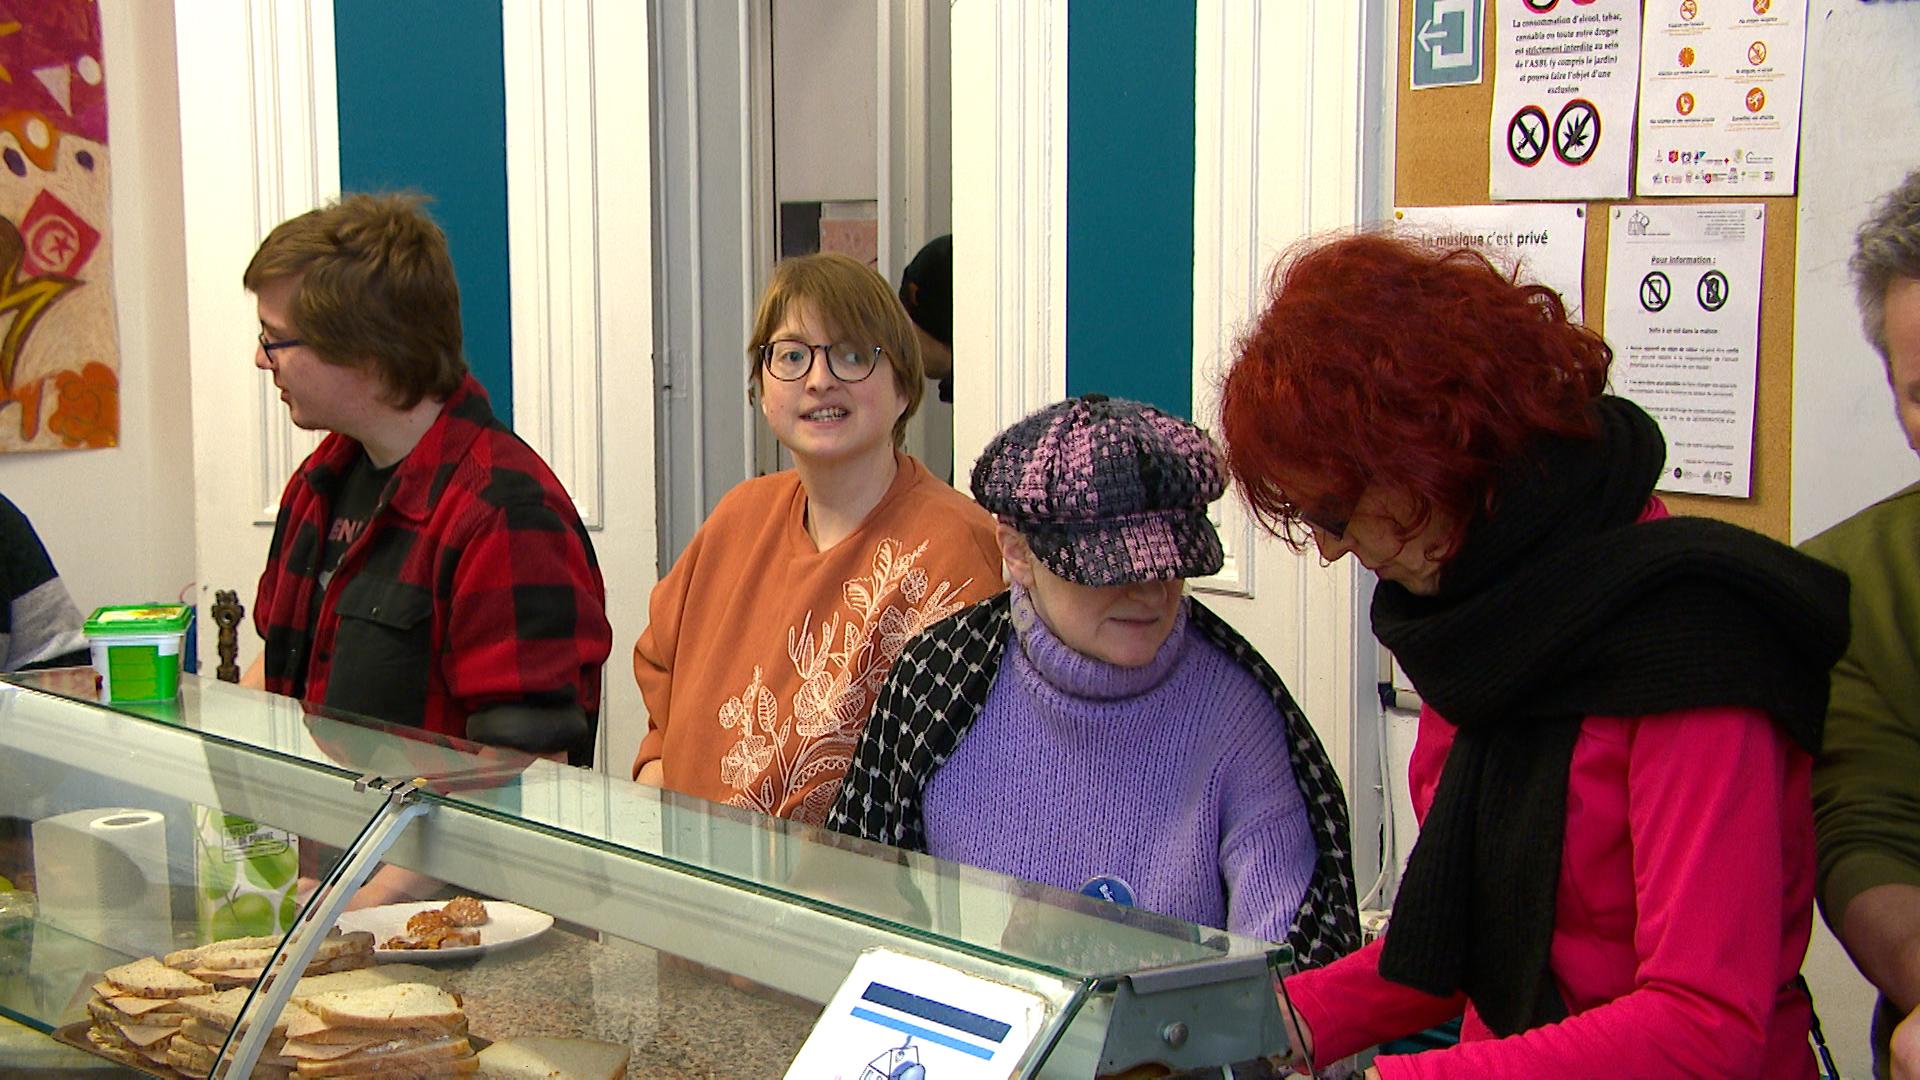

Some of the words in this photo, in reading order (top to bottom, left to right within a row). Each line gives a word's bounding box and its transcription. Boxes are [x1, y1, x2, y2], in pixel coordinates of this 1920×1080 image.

[1512, 20, 1521, 28] La
[1522, 16, 1570, 27] consommation
[1556, 31, 1574, 39] toute
[1575, 30, 1593, 38] autre
[1594, 28, 1619, 38] drogue
[1525, 45, 1562, 56] strictement
[1563, 43, 1592, 54] interdite
[1605, 40, 1619, 49] sein
[1515, 60, 1524, 68] de
[1557, 57, 1585, 69] compris
[1586, 56, 1592, 64] le
[1594, 55, 1618, 66] jardin)
[1550, 71, 1566, 80] faire
[1591, 69, 1611, 79] d'une
[1547, 86, 1579, 94] exclusion
[1436, 232, 1484, 248] musique
[1486, 231, 1514, 246] c'est
[1517, 230, 1548, 248] privé
[1651, 255, 1668, 265] Pour
